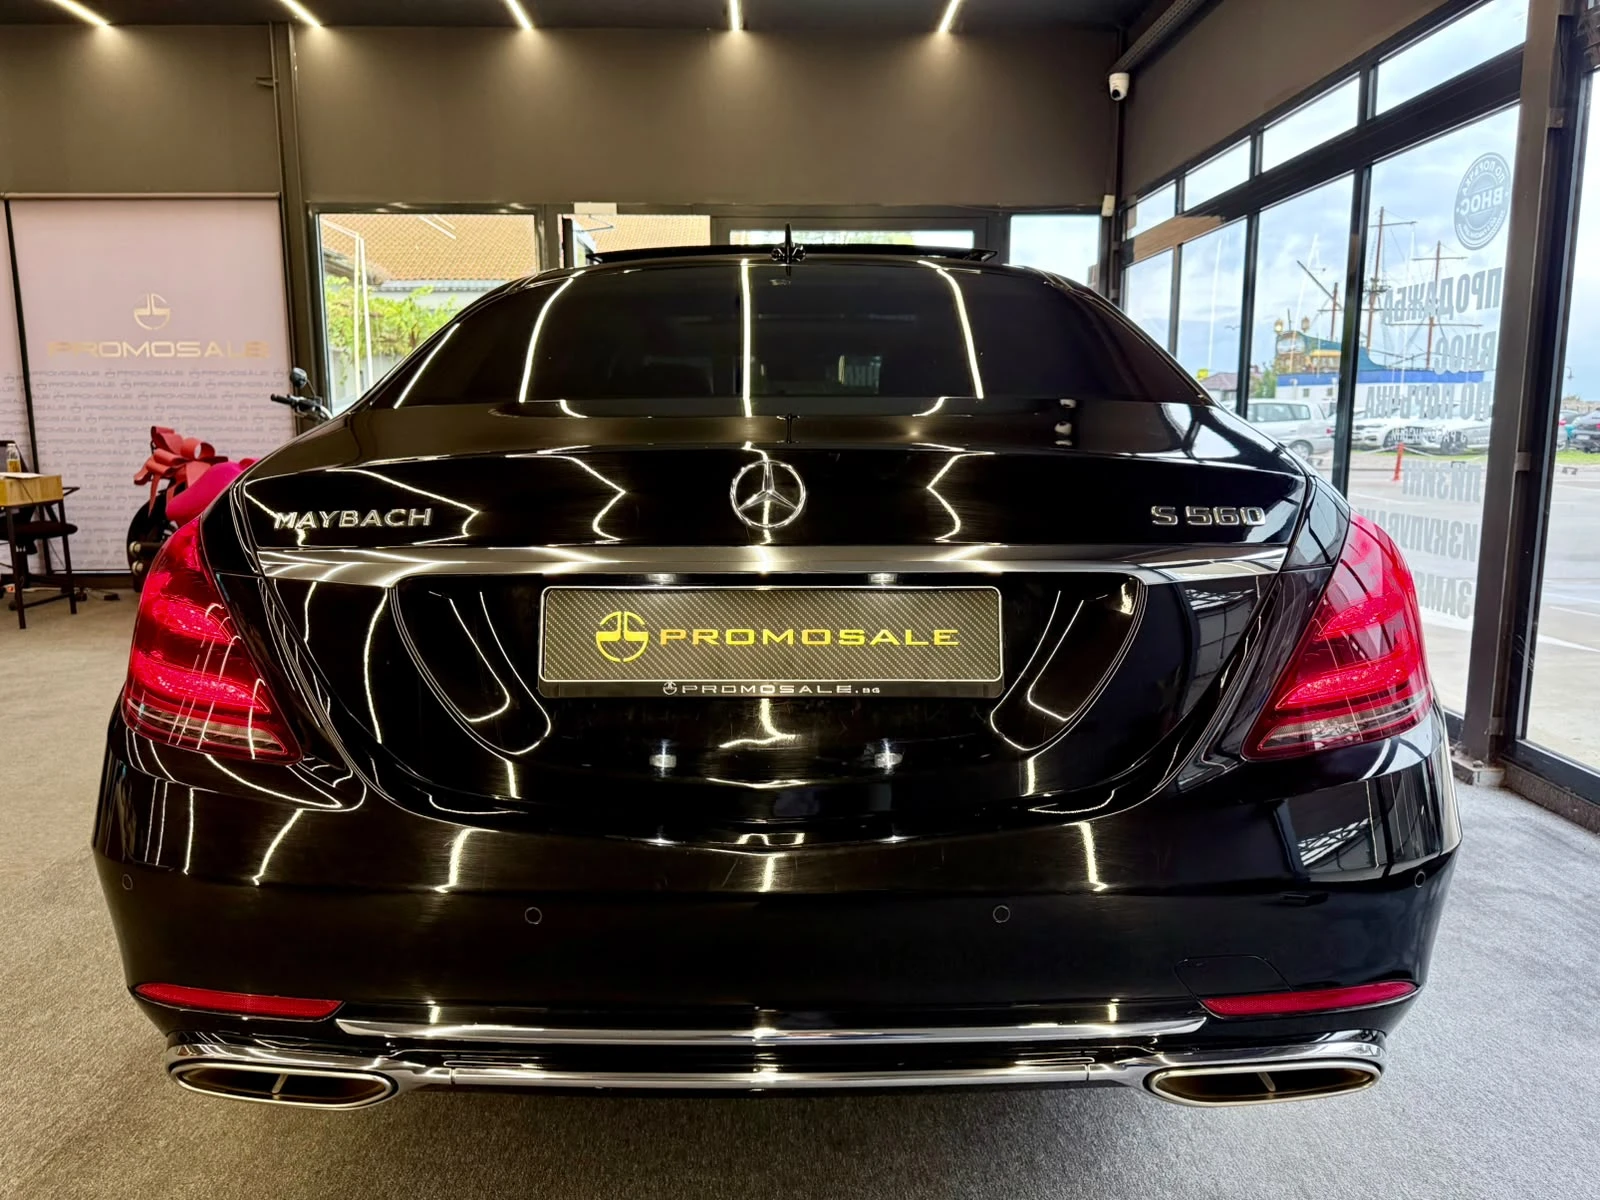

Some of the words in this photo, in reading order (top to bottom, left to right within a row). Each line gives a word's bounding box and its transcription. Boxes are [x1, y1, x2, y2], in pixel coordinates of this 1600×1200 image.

[47, 341, 269, 358] PROMOSALE
[273, 507, 432, 530] MAYBACH
[1150, 505, 1179, 526] S
[1185, 505, 1267, 526] 560
[659, 628, 960, 646] PROMOSALE
[682, 684, 881, 695] PROMOSALE.BG
